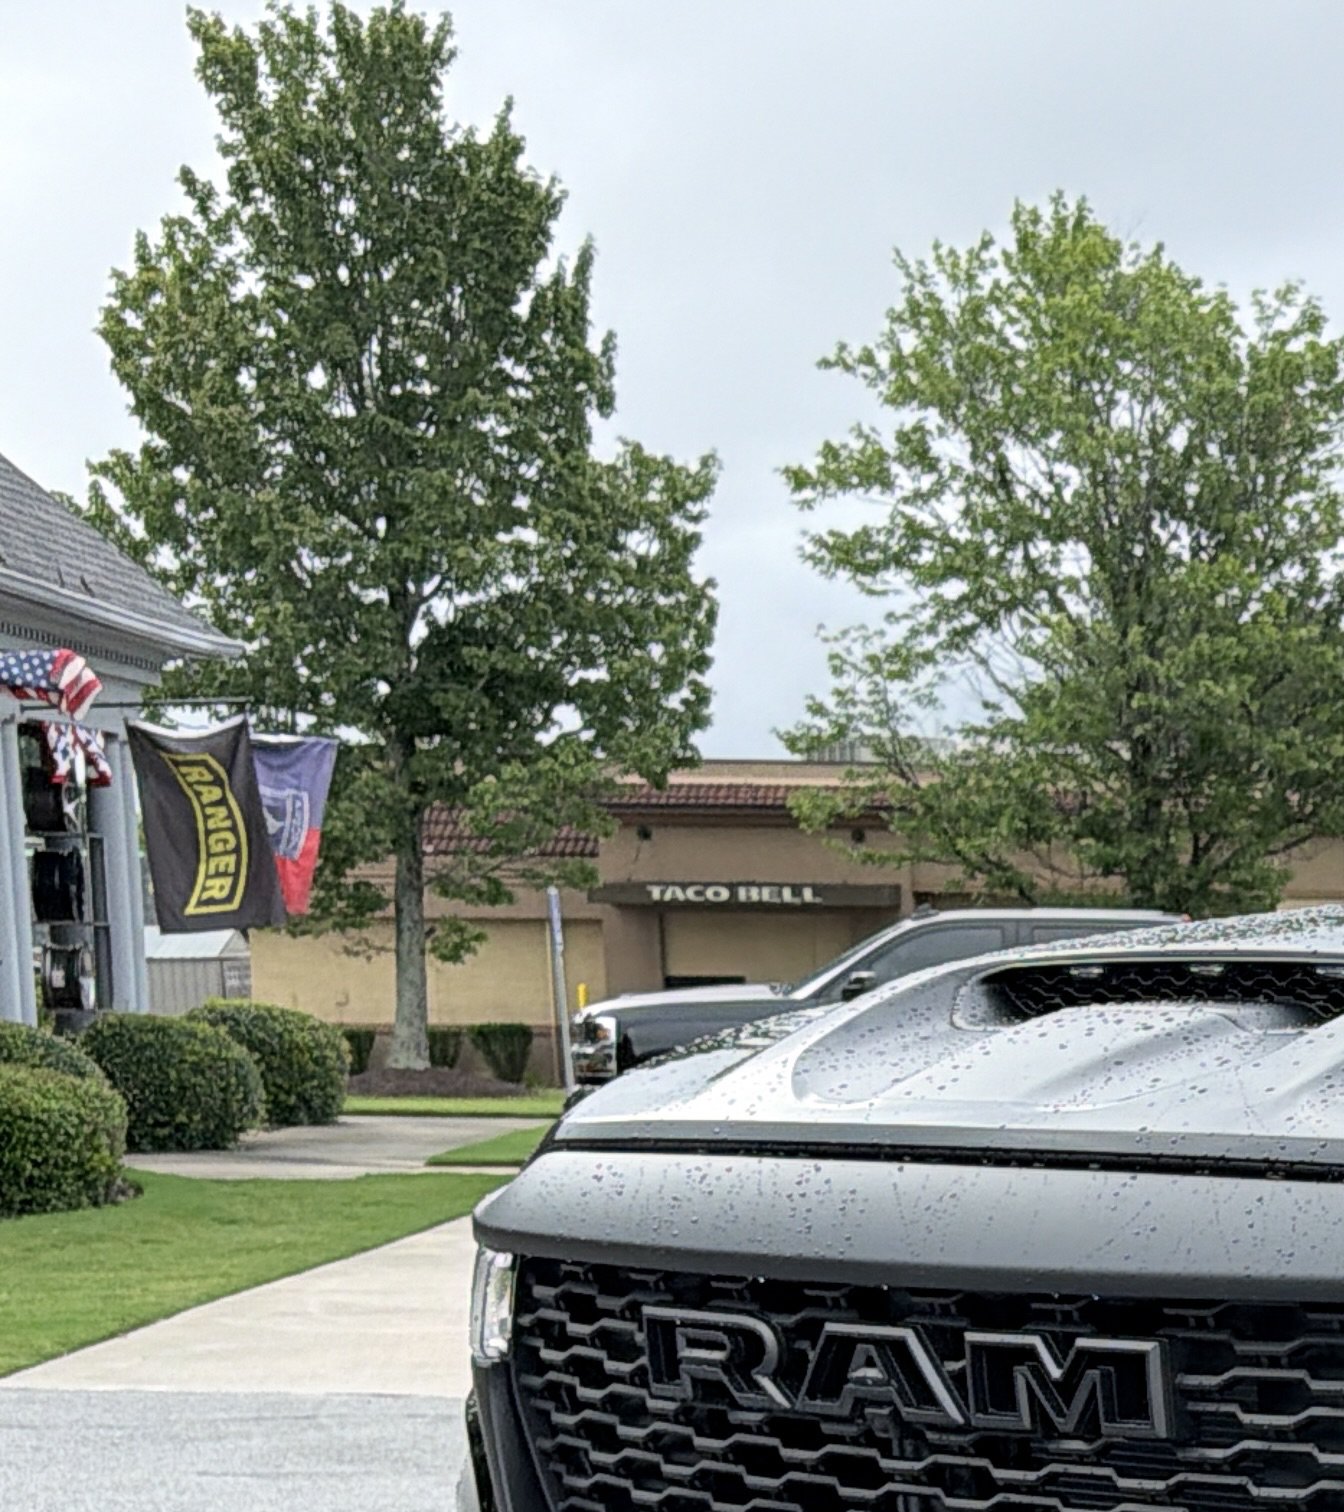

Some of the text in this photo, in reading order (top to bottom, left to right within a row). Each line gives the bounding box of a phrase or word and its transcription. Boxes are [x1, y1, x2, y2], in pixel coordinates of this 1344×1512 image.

[180, 766, 236, 901] RANGER
[647, 884, 822, 904] TACO BELL
[642, 1305, 1170, 1437] RAM
